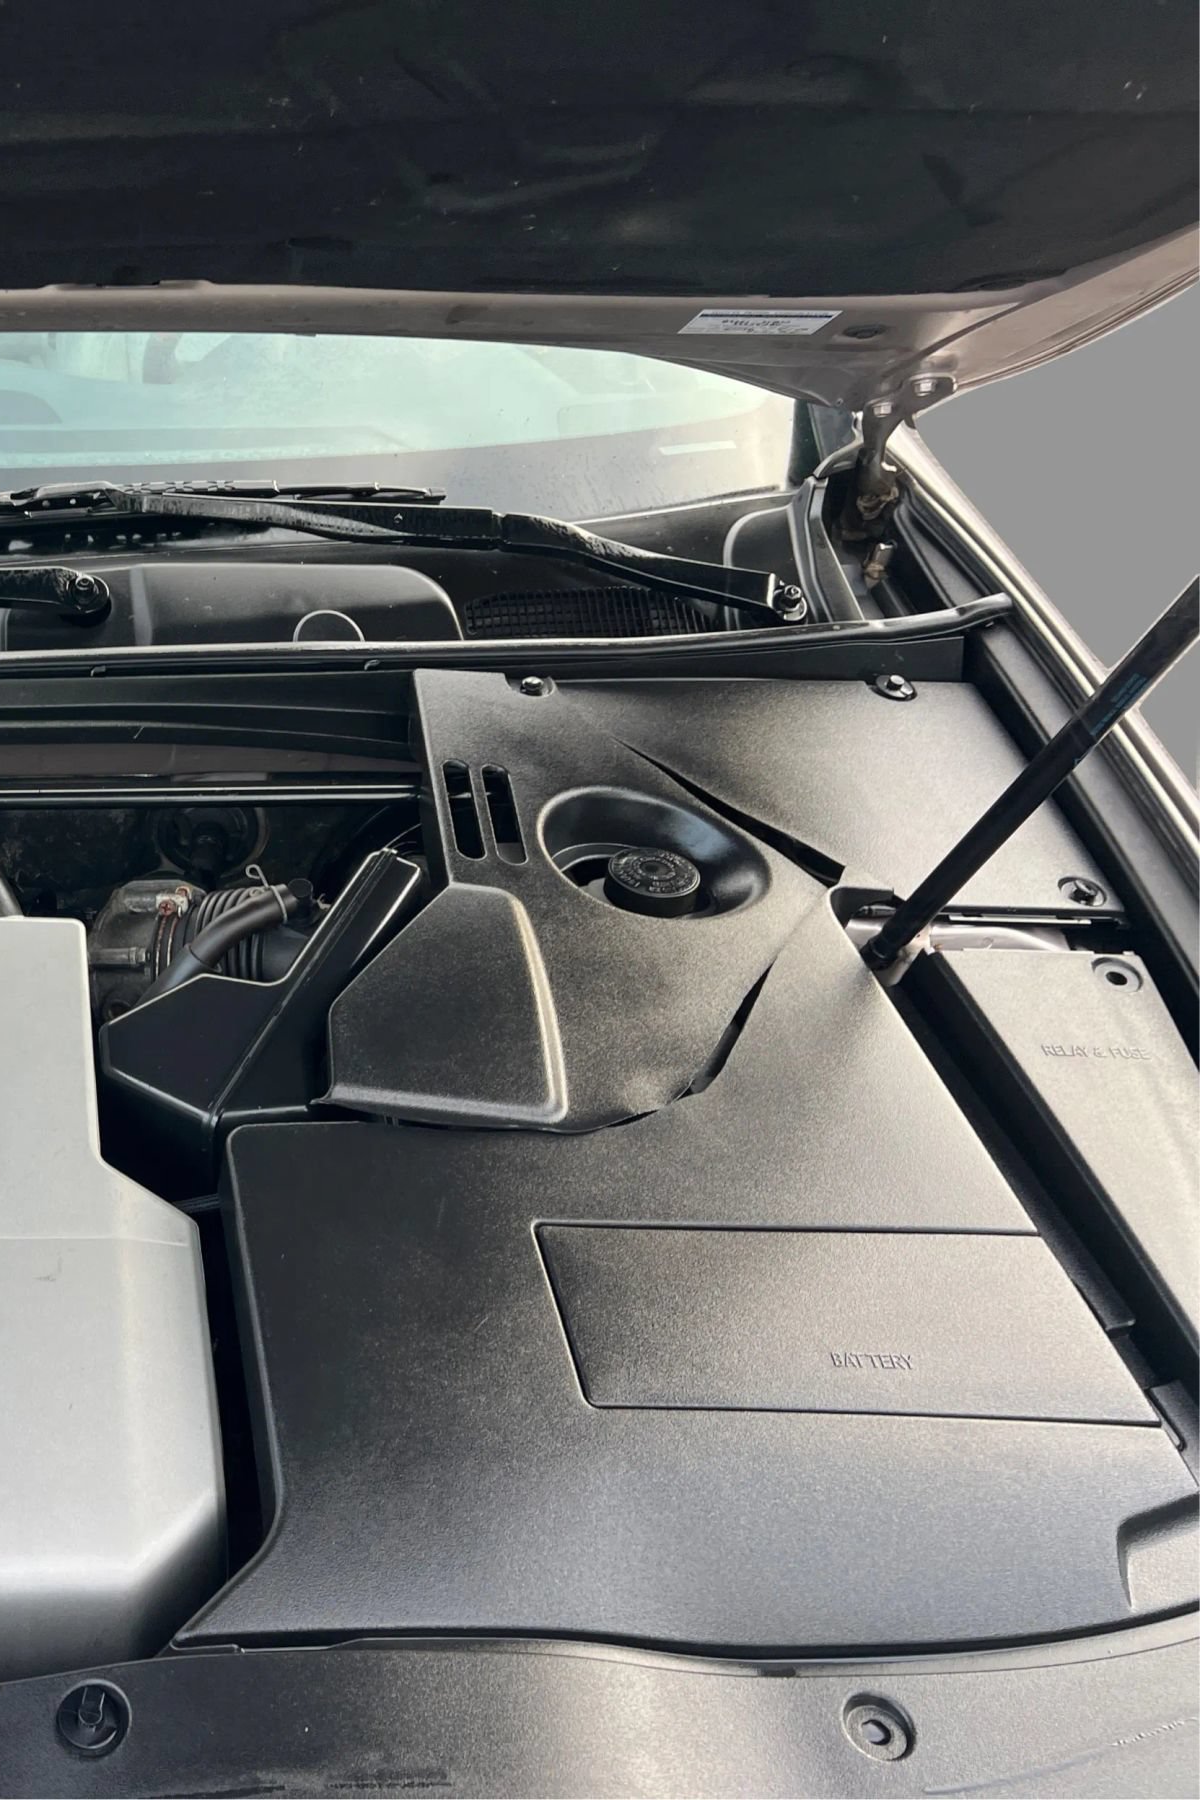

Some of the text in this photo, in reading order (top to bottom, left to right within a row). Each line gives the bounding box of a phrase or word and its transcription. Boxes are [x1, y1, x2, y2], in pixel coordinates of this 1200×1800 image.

[1040, 1044, 1088, 1057] RELAY
[1108, 1047, 1152, 1060] FUSE
[829, 1352, 913, 1370] BATTERY
